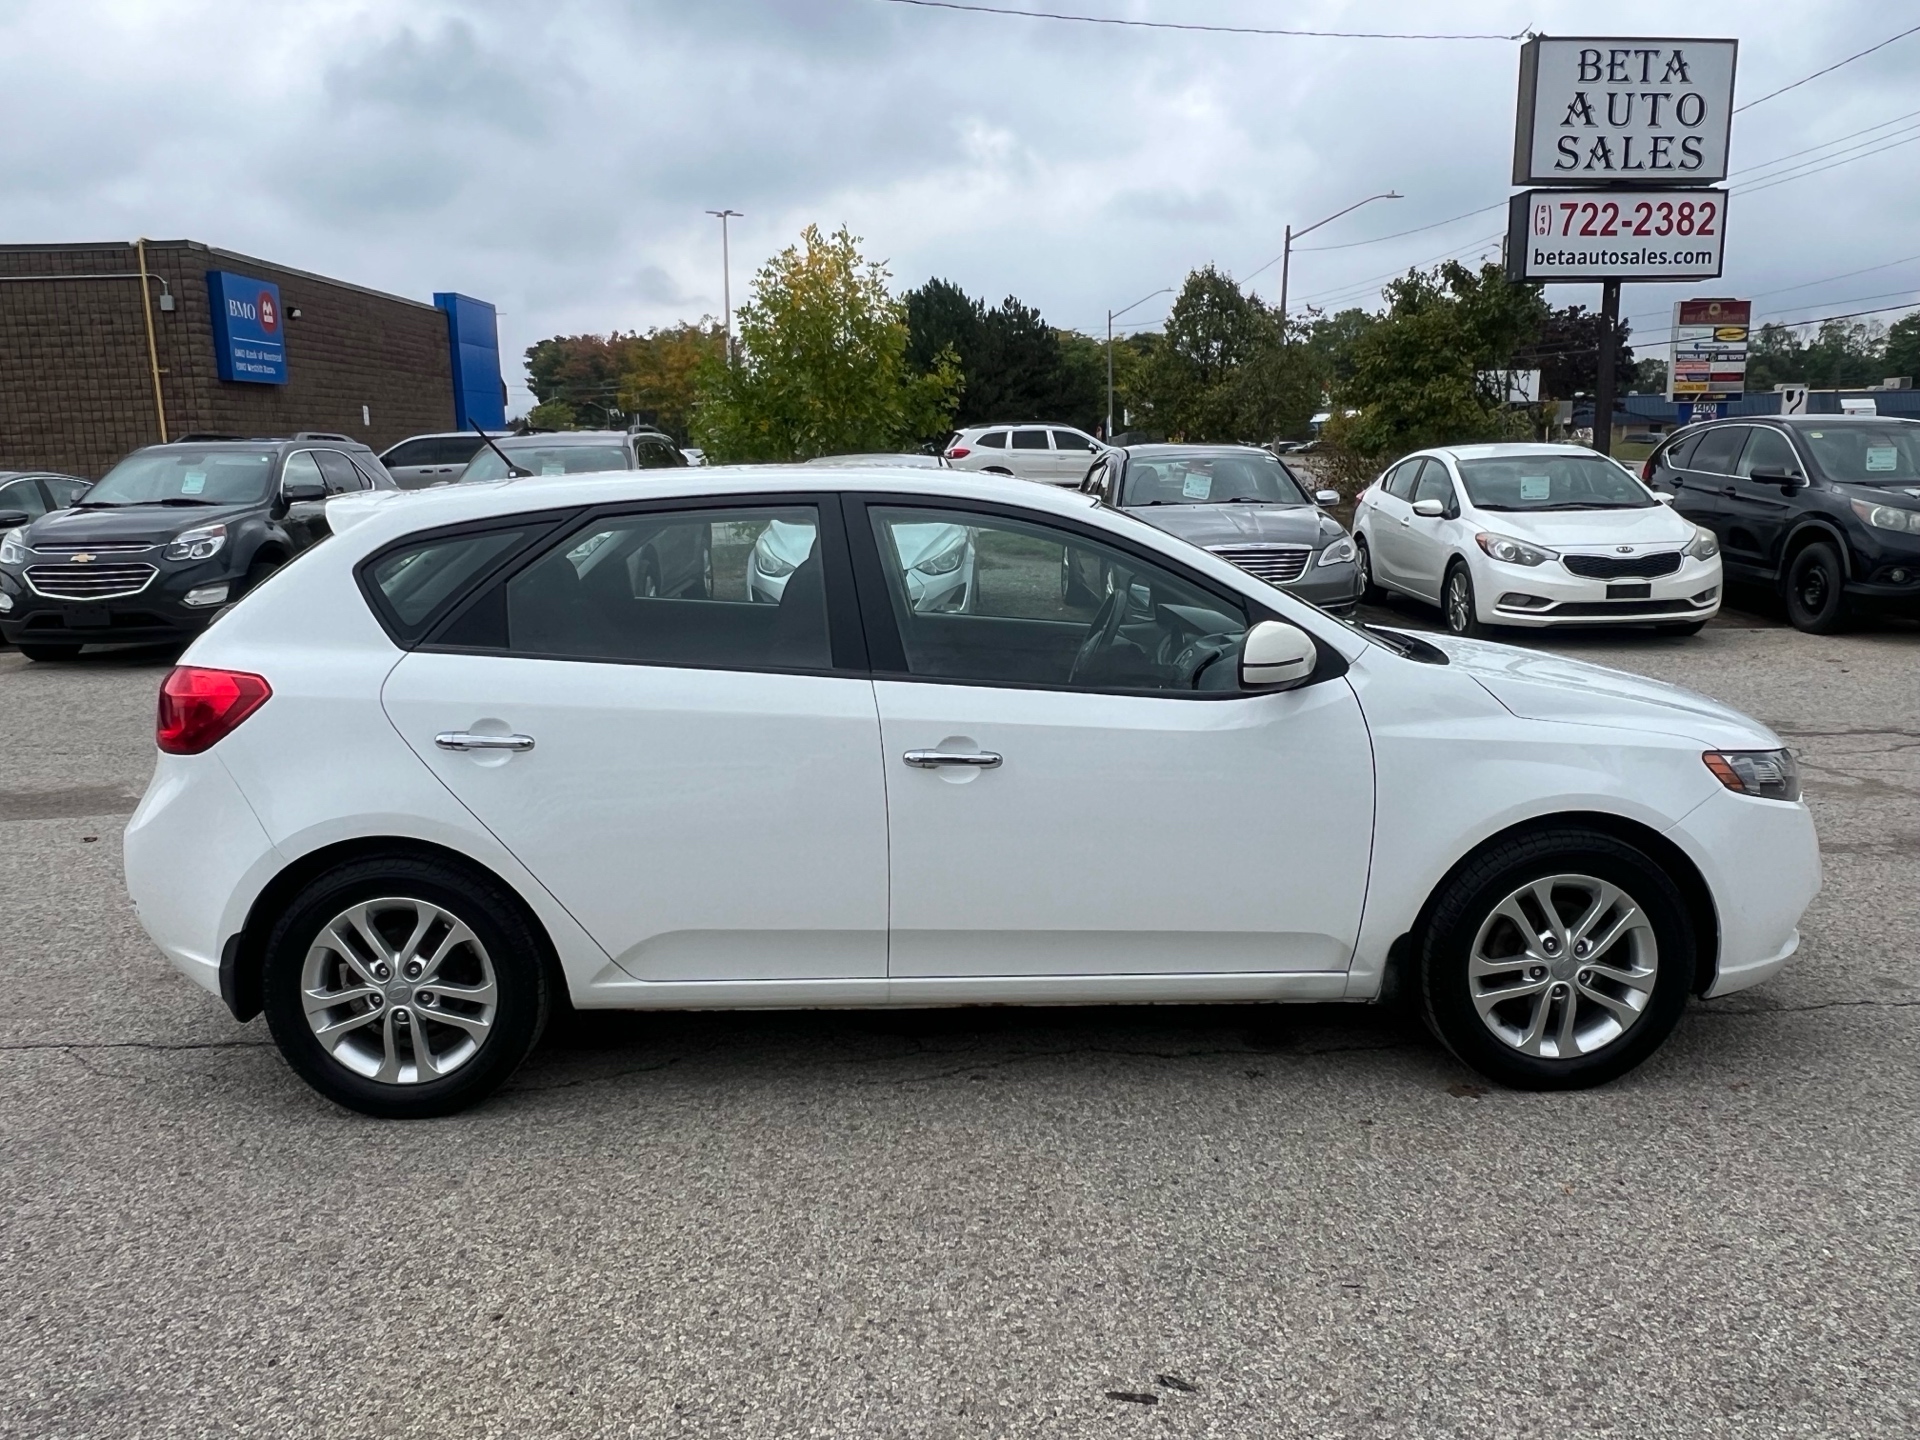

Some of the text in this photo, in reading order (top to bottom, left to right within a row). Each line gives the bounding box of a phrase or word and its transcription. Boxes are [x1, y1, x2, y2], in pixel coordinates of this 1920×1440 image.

[1578, 49, 1693, 84] BETA
[1560, 92, 1707, 129] AUTO
[1554, 135, 1706, 171] SALES
[1560, 202, 1716, 236] 722-2382
[1533, 248, 1712, 265] betaautosales.com
[229, 299, 256, 320] BMO
